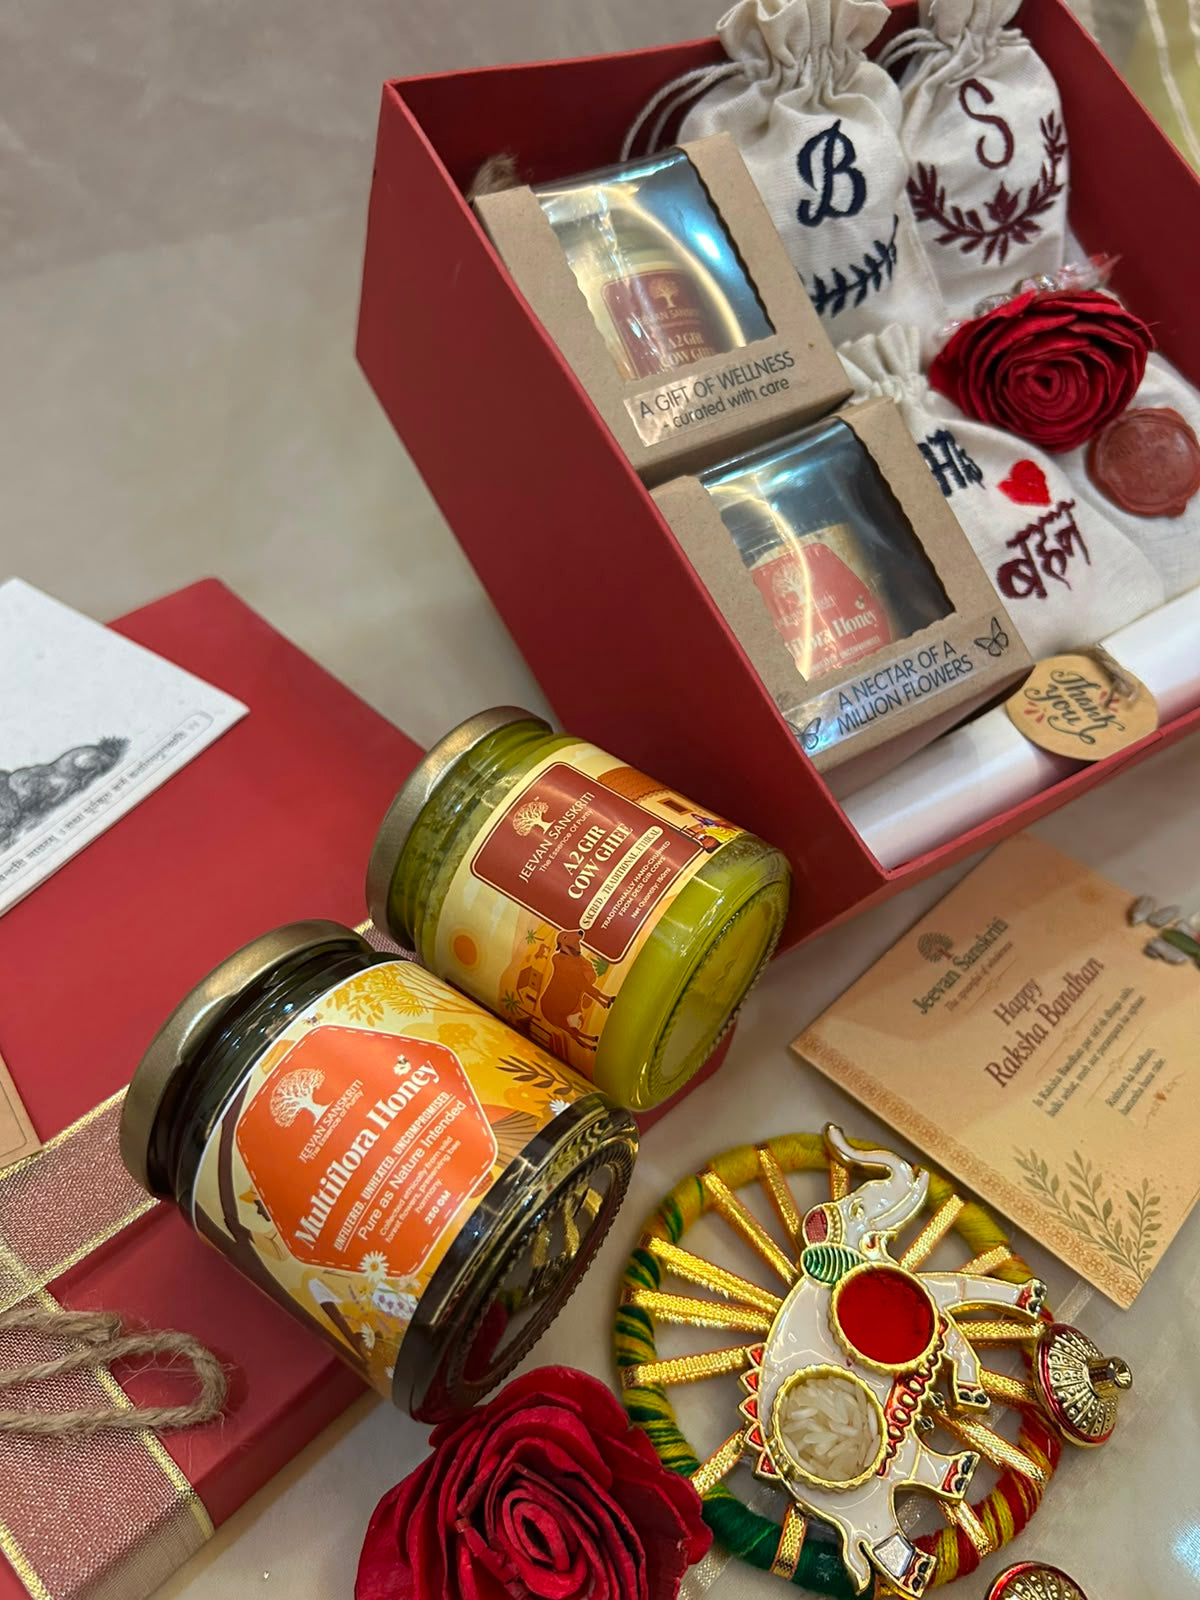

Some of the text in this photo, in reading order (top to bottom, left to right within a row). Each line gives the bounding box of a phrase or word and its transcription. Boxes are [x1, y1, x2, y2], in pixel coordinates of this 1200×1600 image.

[959, 79, 1014, 170] S
[797, 119, 867, 227] B
[640, 350, 796, 419] A GIFT OF WELLNESS
[673, 400, 726, 428] curated
[728, 387, 758, 410] with
[760, 376, 790, 398] care
[837, 654, 974, 736] MILLION FLOWERS
[838, 640, 957, 710] A NECTAR OF A
[1050, 669, 1126, 733] Thank
[519, 792, 594, 882] JEEVAN SANSKRITI
[539, 859, 551, 872] The
[549, 833, 572, 859] Essence
[576, 807, 594, 825] Purity
[563, 826, 606, 875] A2 GIR
[568, 823, 632, 898] COW GHEE
[582, 897, 603, 926] SACRED
[602, 852, 638, 894] TRADITIONAL
[602, 882, 635, 928] TRADITIONALLY
[618, 855, 666, 916] FROM DESI GIR COWS
[631, 907, 641, 918] Net
[912, 966, 961, 1015] Jeevan
[953, 916, 1009, 972] Sanskriti
[993, 978, 1043, 1027] Happy
[984, 1022, 1049, 1088] Raksha
[1037, 957, 1105, 1028] Bandhan
[295, 1060, 440, 1250] Multiflora Honey
[299, 1080, 362, 1162] JEEVAN SANSKRITI
[307, 1144, 320, 1159] The
[316, 1115, 341, 1146] Essence
[343, 1088, 363, 1109] Purity
[335, 1092, 450, 1250] UNFILTERED. UNHEATED. UNCOMPROMISED.
[358, 1098, 466, 1240] Pure as Nature Intended
[380, 1136, 453, 1235] Collected ethically from wild
[385, 1220, 402, 1243] forest
[419, 1154, 450, 1193] preserving
[446, 1140, 461, 1154] bee
[425, 1190, 451, 1224] 250 GM
